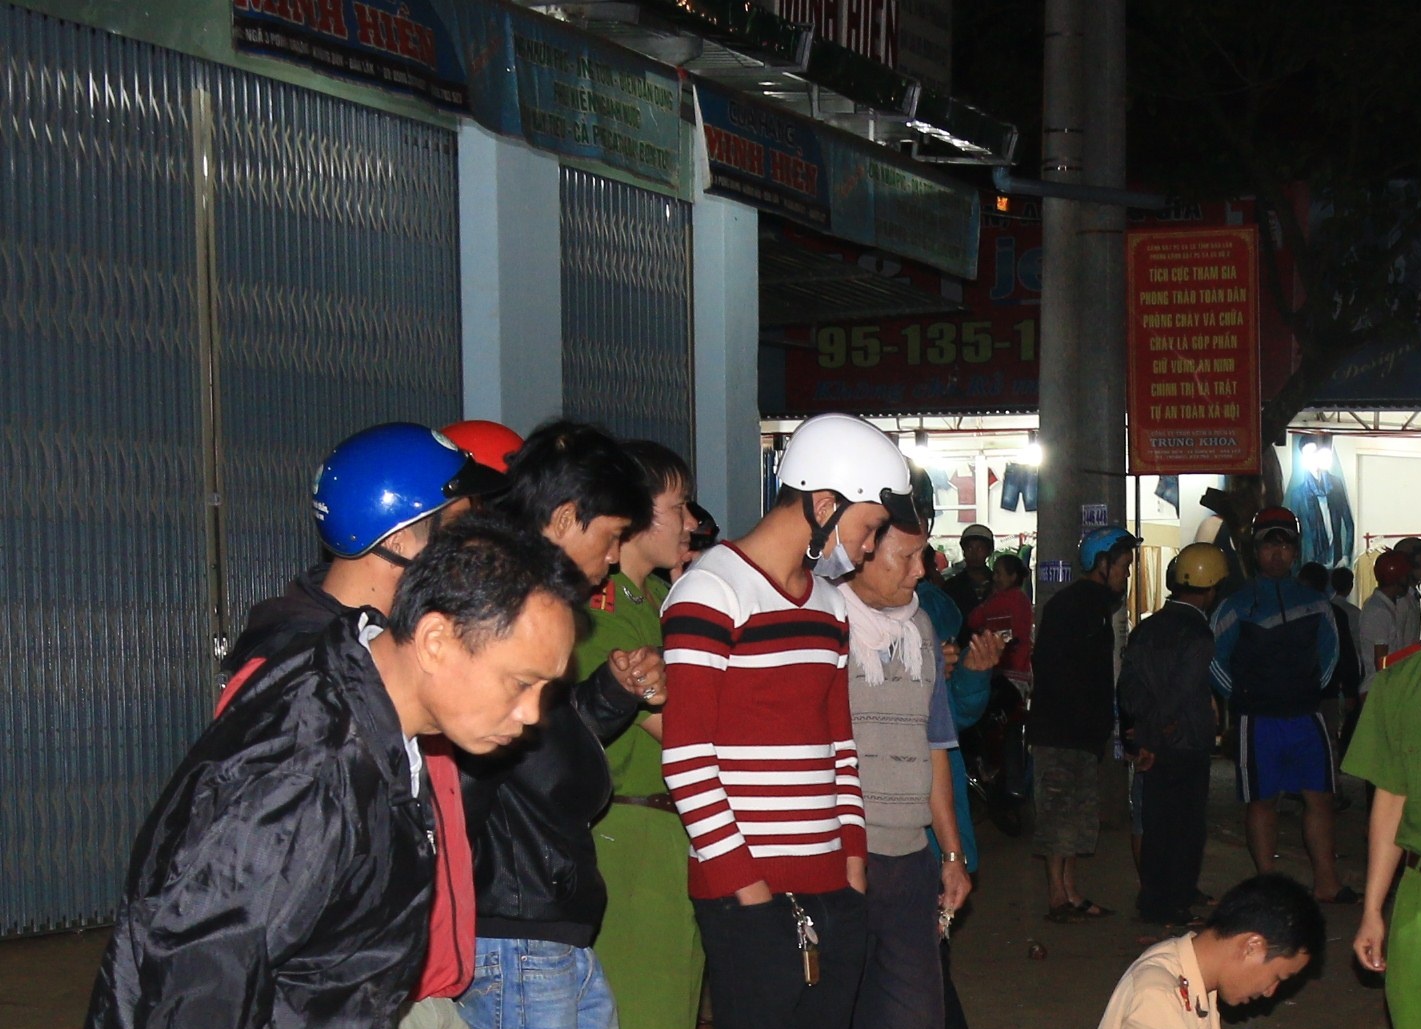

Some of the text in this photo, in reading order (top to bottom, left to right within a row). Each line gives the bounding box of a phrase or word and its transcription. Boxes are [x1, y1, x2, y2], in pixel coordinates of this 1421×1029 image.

[1149, 265, 1169, 282] TÍCH
[1193, 265, 1219, 280] THAM
[1221, 264, 1237, 280] GIA
[1140, 286, 1247, 306] PHONG TRÀO TOÀN DÂN
[1203, 309, 1216, 327] VÀ
[816, 318, 1037, 369] 95-135-1
[1214, 358, 1235, 373] NINH
[1165, 405, 1178, 420] AN
[1181, 402, 1205, 419] TOÀN
[1150, 436, 1237, 448] TRUNG KHOA
